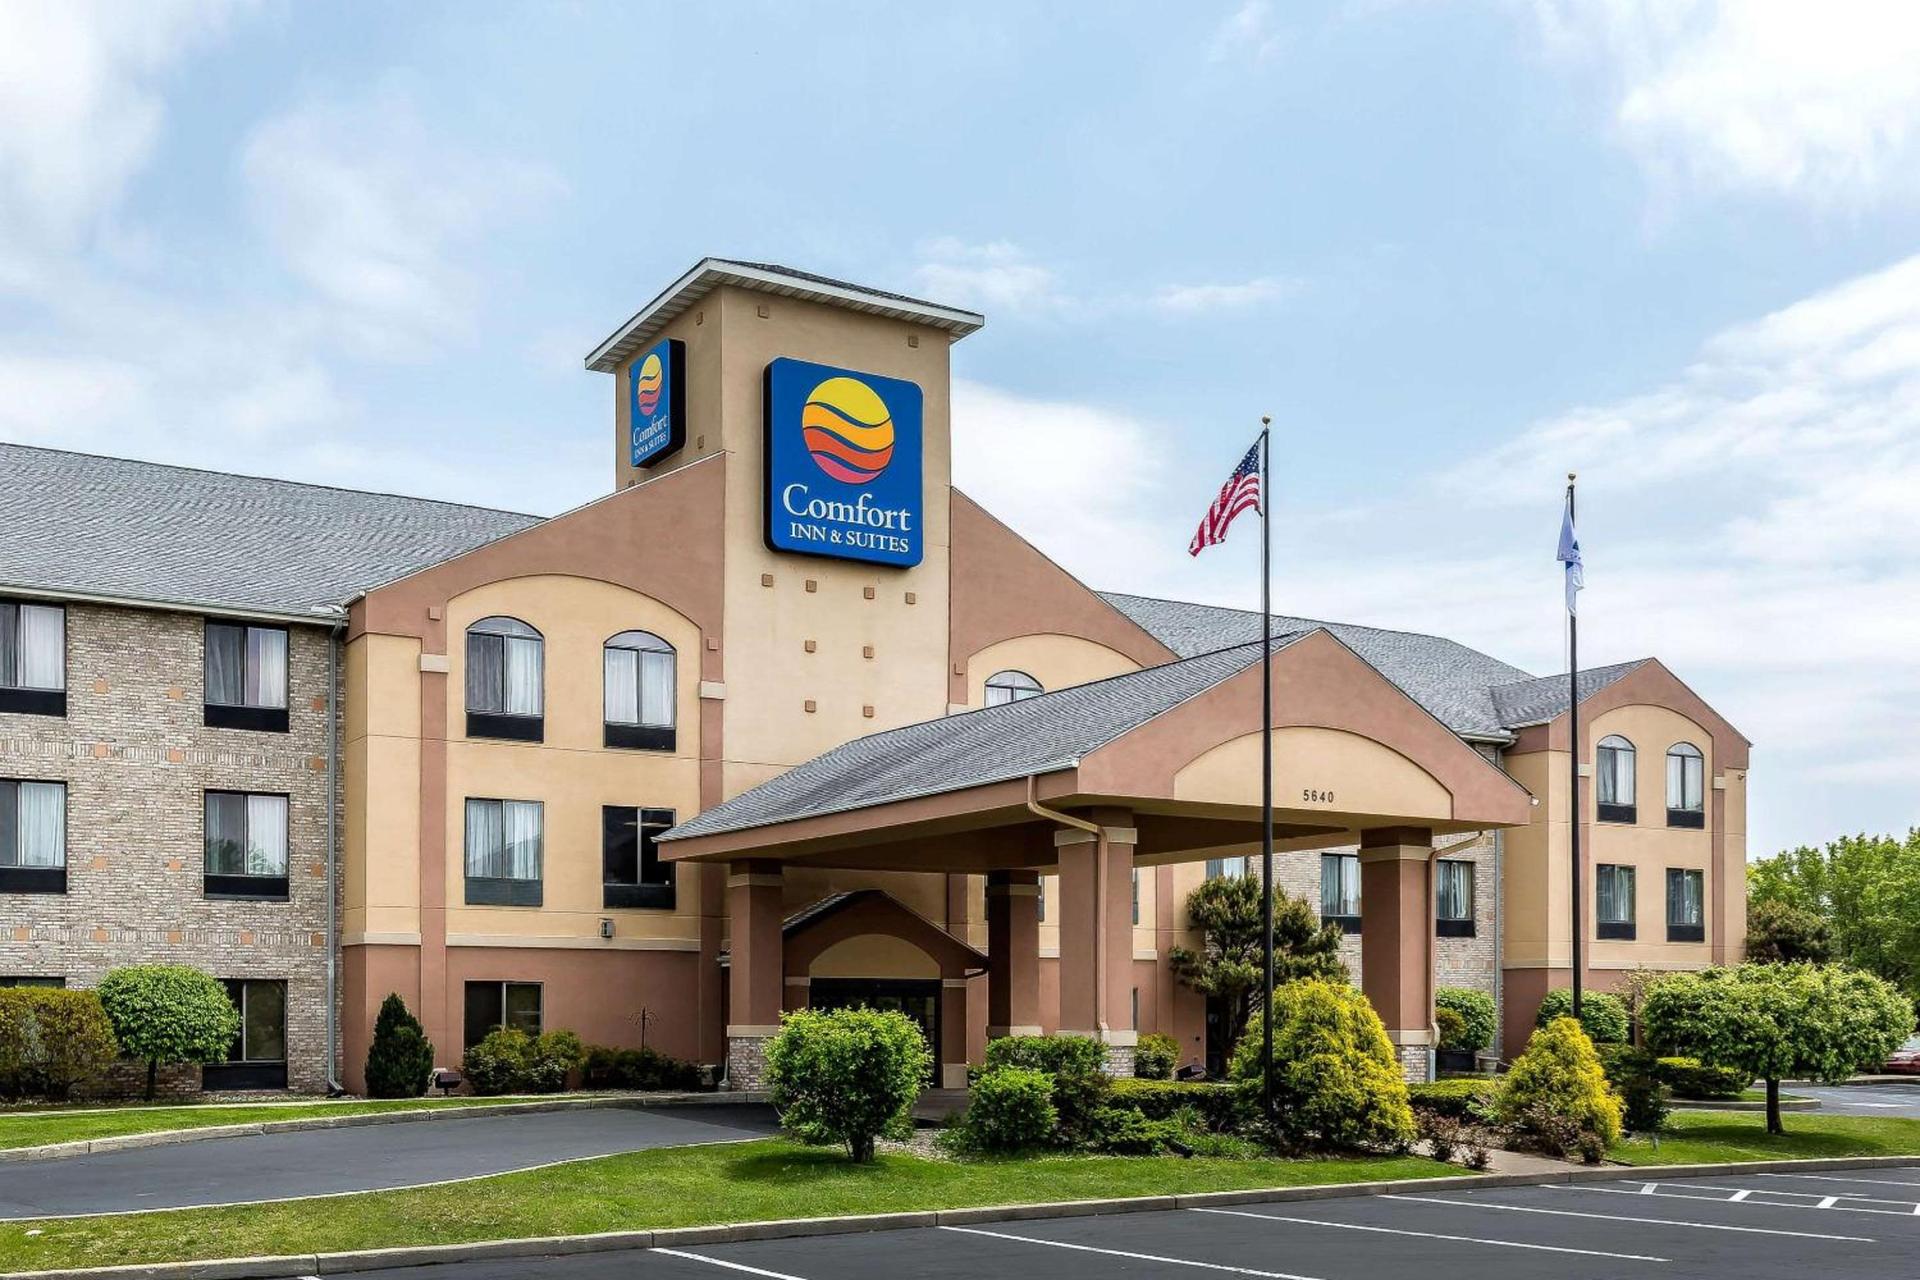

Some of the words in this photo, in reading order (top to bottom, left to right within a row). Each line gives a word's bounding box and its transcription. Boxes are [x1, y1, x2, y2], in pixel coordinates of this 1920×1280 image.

[633, 414, 667, 446] Comfort
[783, 483, 912, 531] Comfort
[790, 522, 827, 541] INN
[830, 529, 844, 544] &
[846, 530, 909, 553] SUITES
[1303, 789, 1334, 803] 5640
